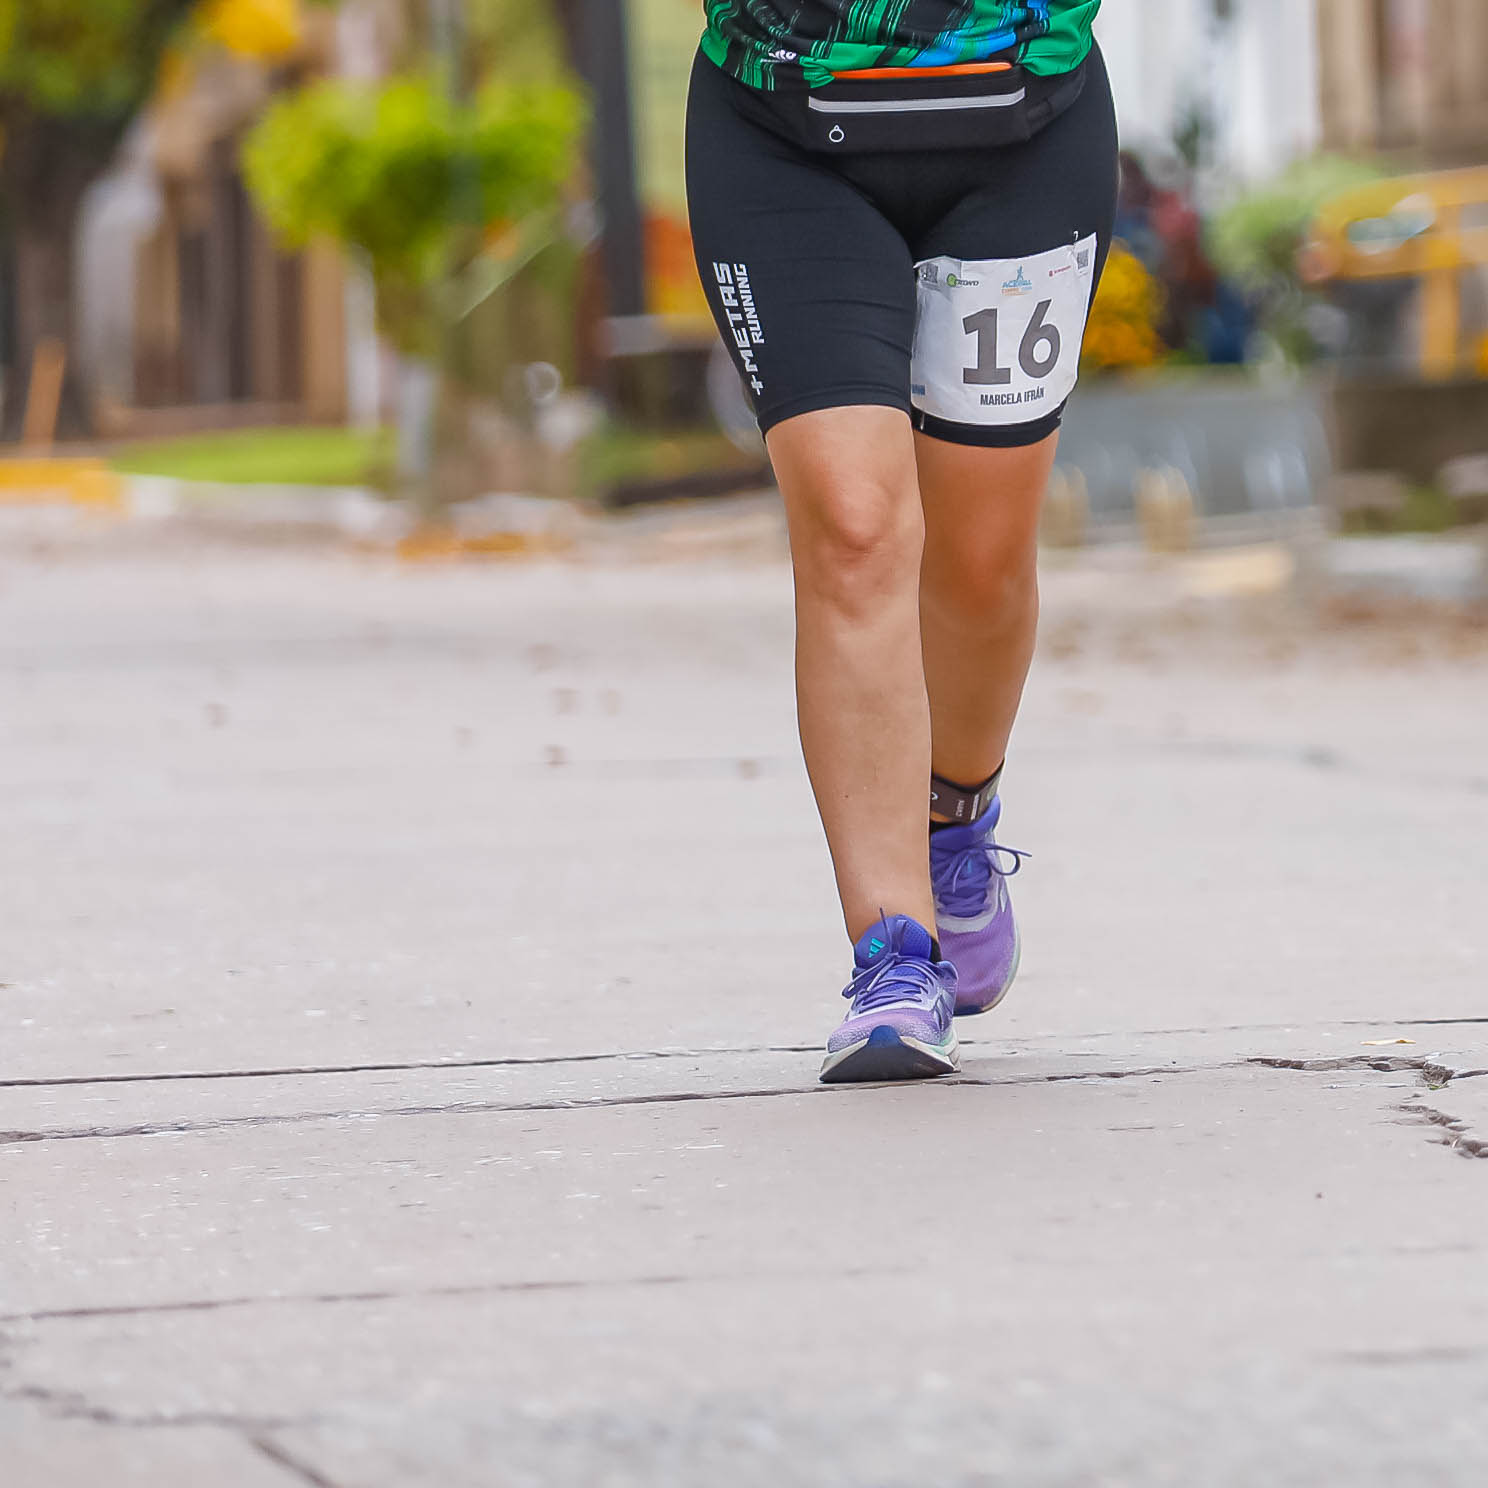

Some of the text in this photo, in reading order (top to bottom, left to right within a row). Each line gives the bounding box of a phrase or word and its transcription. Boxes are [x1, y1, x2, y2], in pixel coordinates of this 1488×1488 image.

[712, 261, 764, 396] +METAS
[733, 263, 765, 344] RUNNING
[962, 299, 1061, 384] 16
[980, 386, 1045, 406] MARCELA IFRÁN
